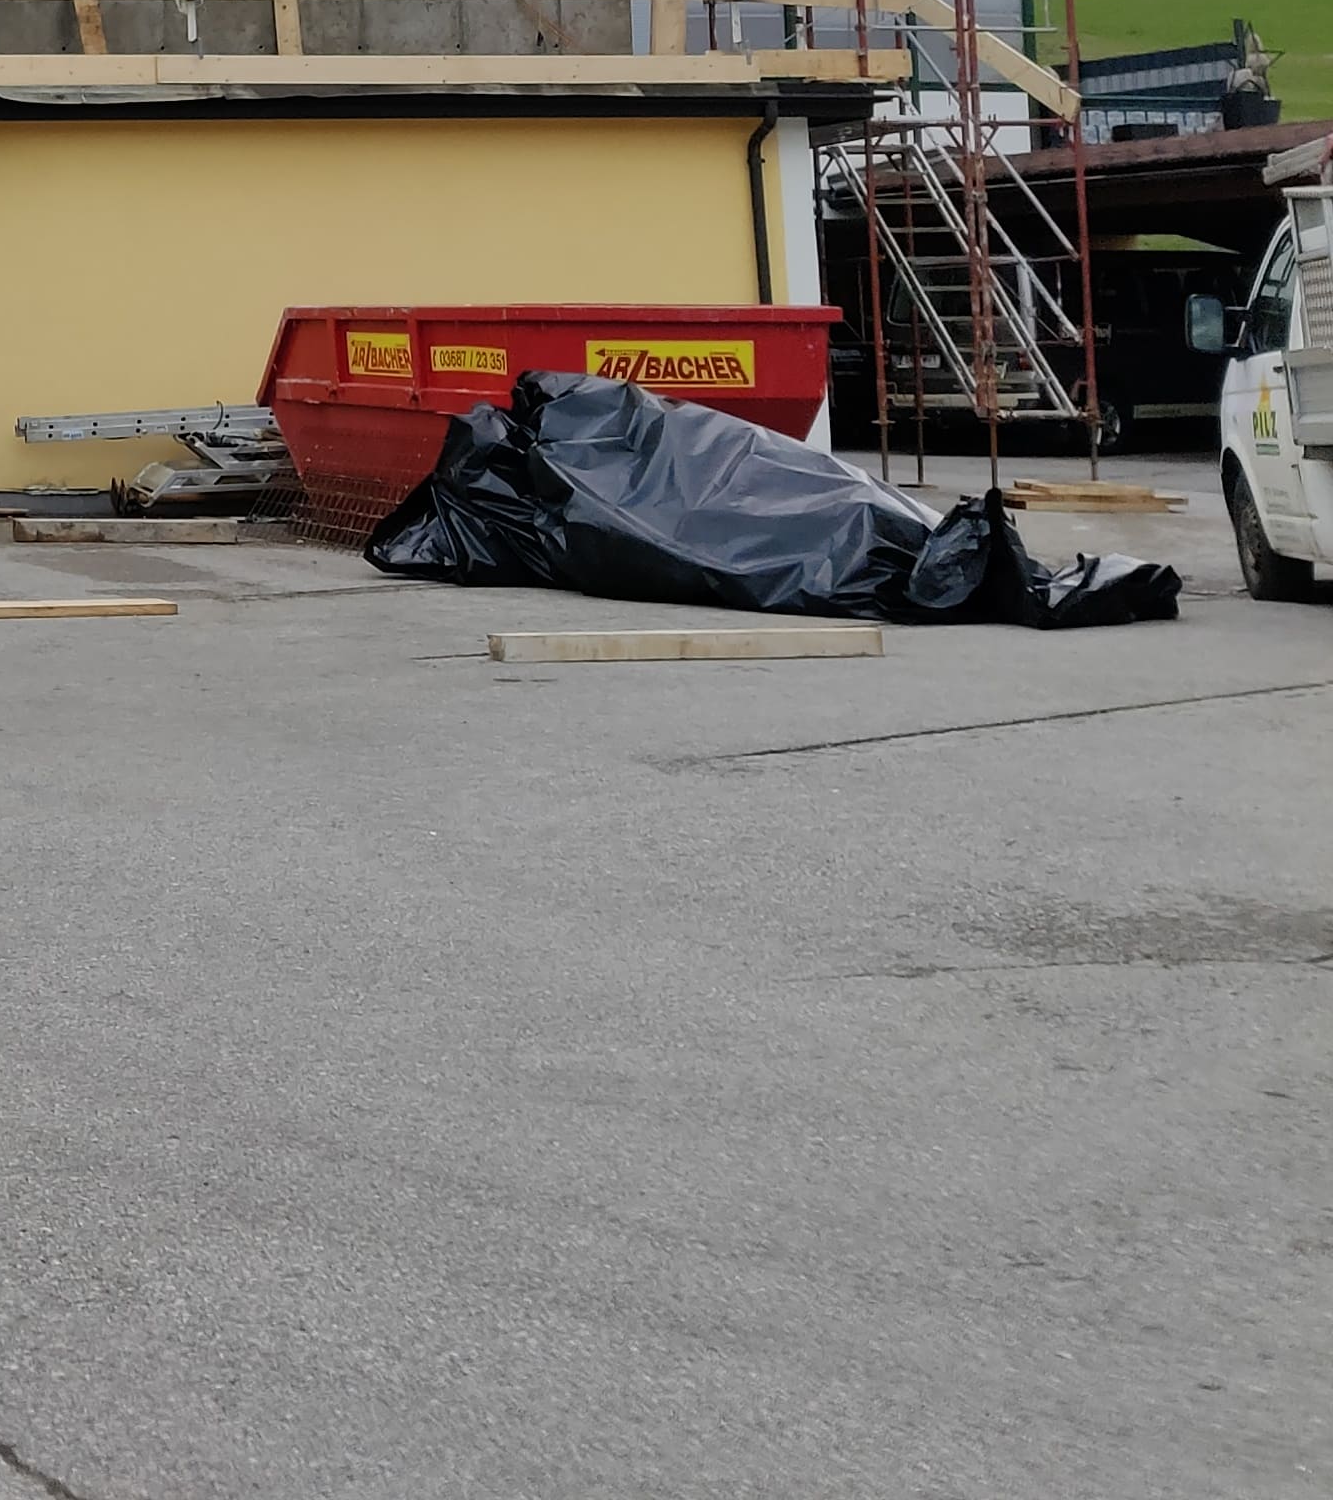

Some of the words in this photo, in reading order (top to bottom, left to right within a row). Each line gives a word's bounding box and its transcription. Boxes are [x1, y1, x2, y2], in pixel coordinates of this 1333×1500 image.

[439, 350, 466, 366] 03687
[476, 351, 488, 367] 23
[490, 353, 506, 371] 351
[1252, 411, 1278, 439] PILZ
